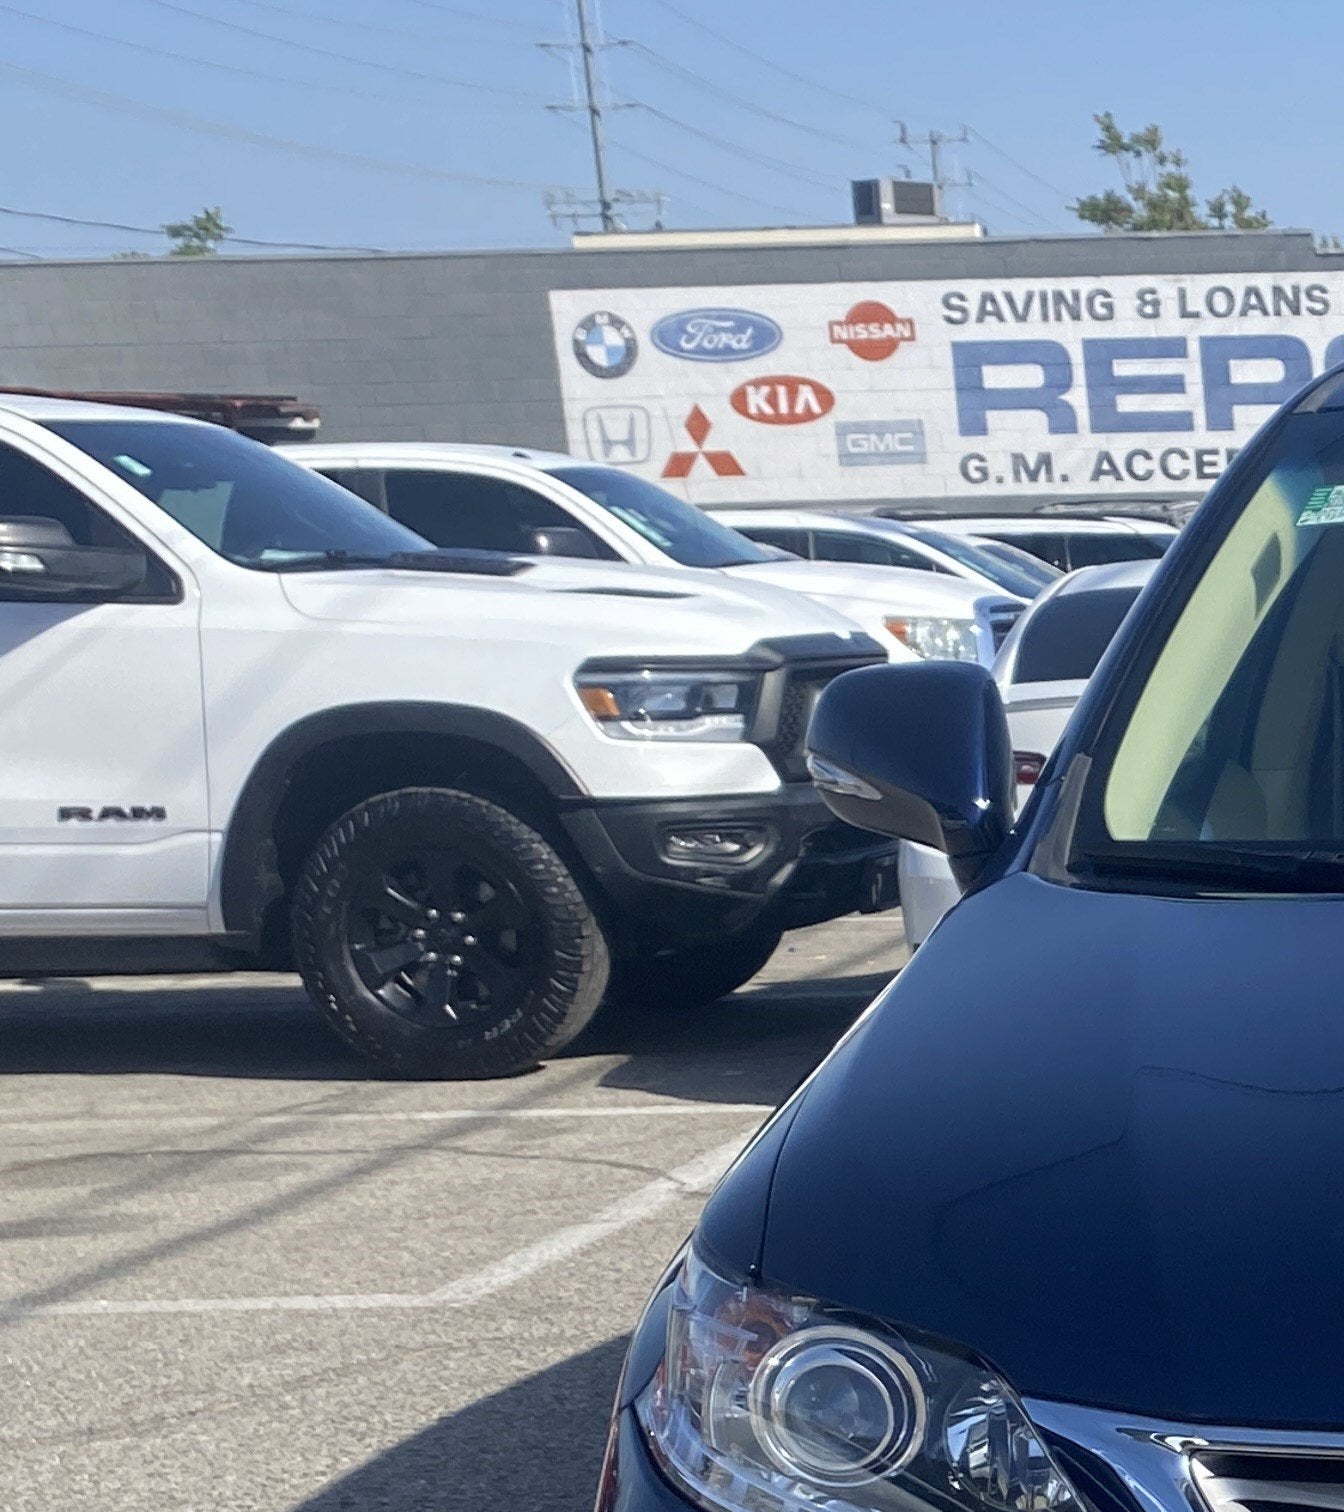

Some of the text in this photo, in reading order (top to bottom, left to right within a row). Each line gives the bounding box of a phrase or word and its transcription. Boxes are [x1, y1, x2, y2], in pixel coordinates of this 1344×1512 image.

[941, 288, 1115, 326] SAVING
[1136, 287, 1161, 319] &
[1178, 283, 1330, 320] LOANS
[680, 318, 752, 352] Ford
[832, 323, 912, 341] NISSAN
[745, 385, 822, 416] KIA
[847, 432, 914, 453] GMC
[960, 451, 1068, 485] G.M.
[57, 805, 167, 822] RAM
